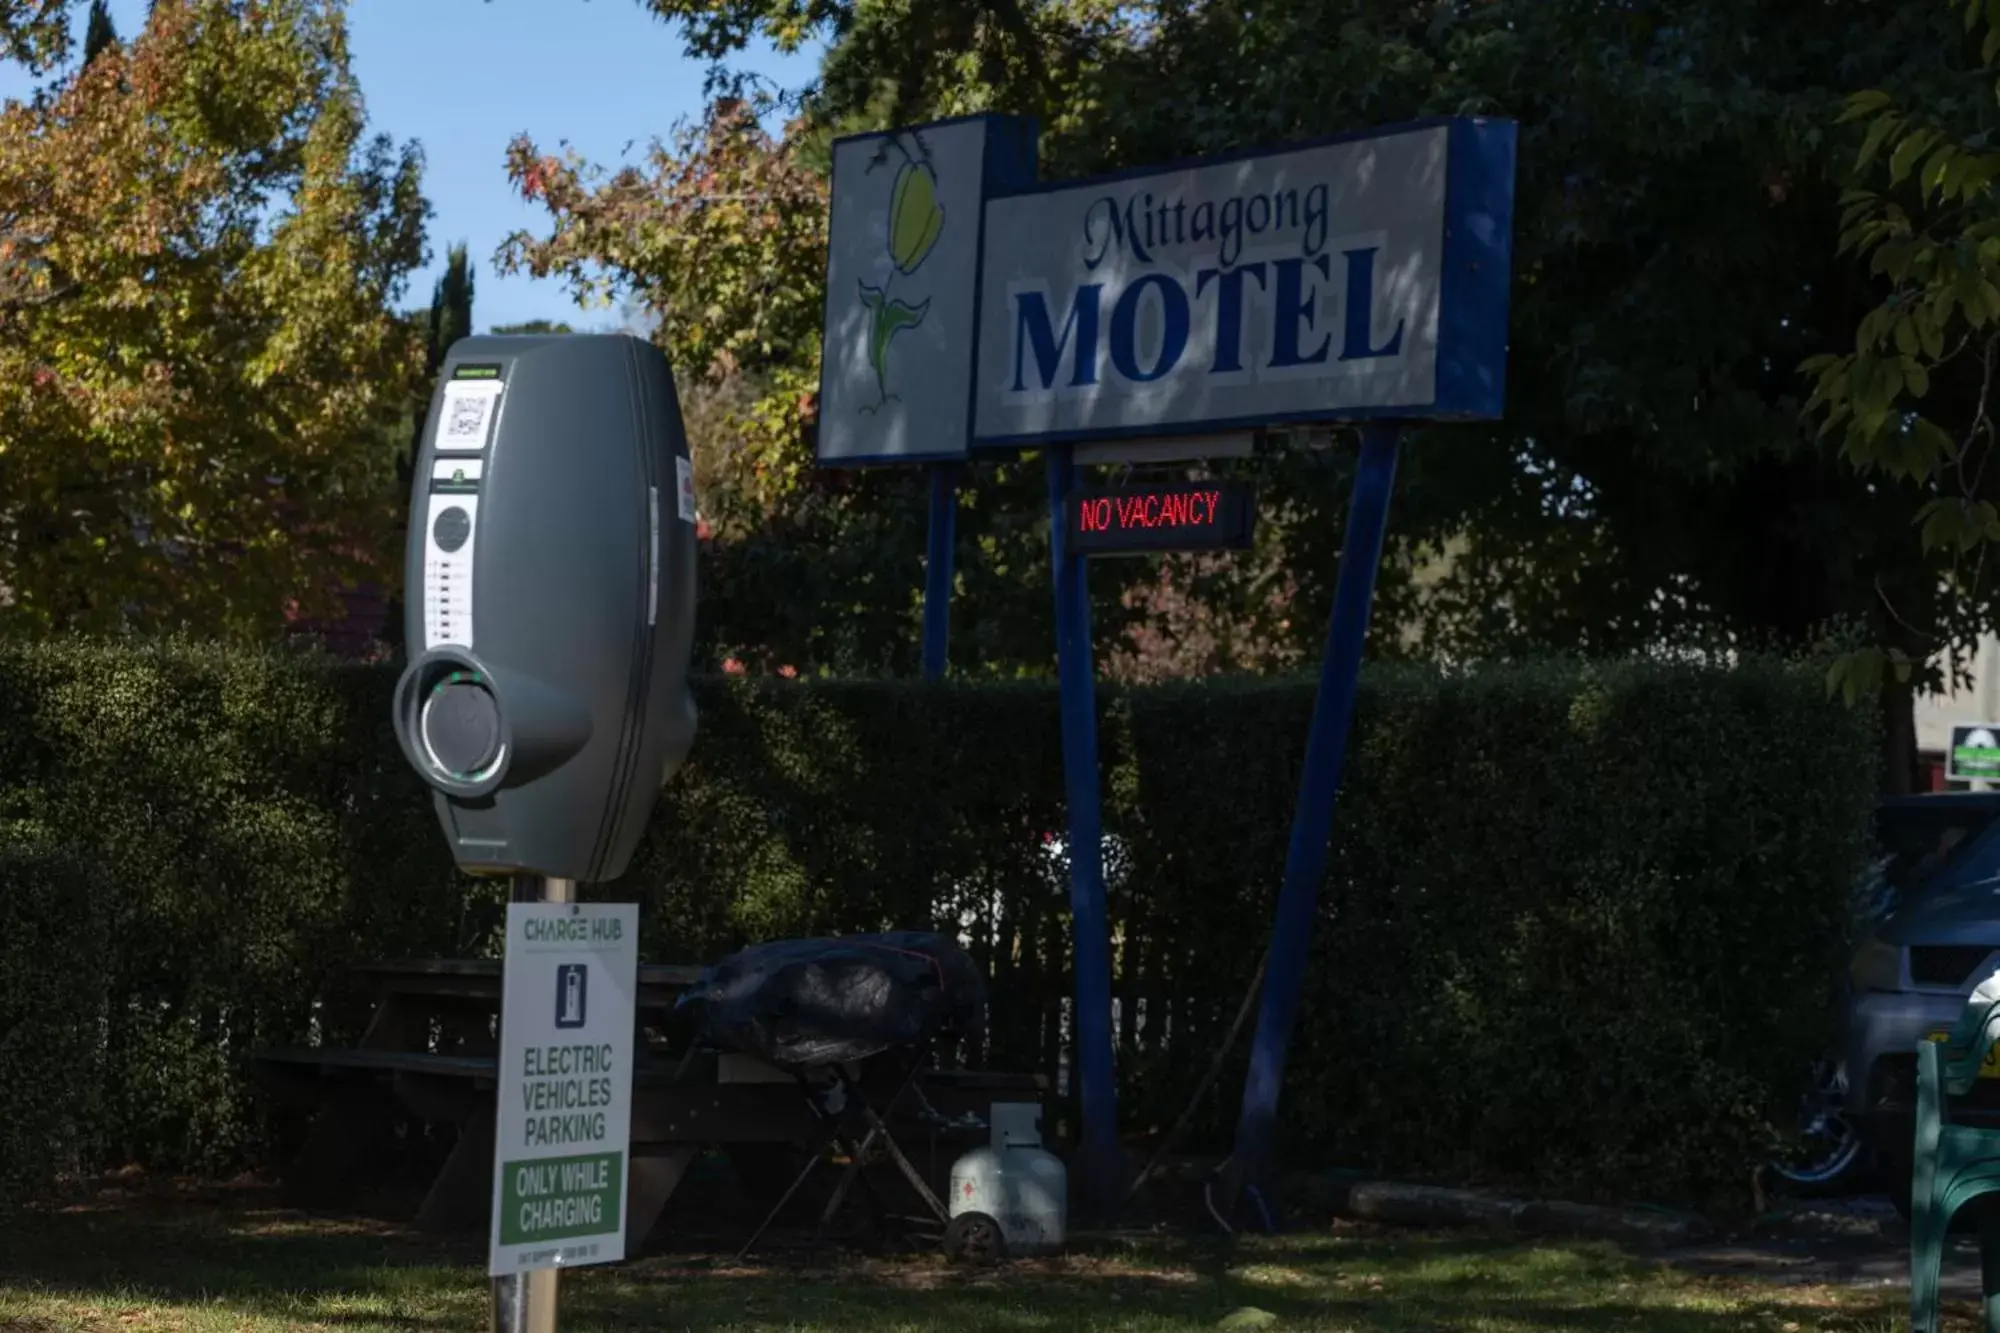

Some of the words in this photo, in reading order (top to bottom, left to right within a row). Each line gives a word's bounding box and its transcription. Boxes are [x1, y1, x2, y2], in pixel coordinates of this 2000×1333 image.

[1083, 183, 1329, 269] Mittagong
[1010, 247, 1404, 391] MOTEL
[1080, 499, 1112, 532] NO
[1116, 490, 1220, 528] VACANCY
[524, 918, 587, 941] CHARGE
[592, 918, 623, 941] HUB
[523, 1044, 612, 1077] ELECTRIC
[522, 1078, 611, 1111] VEHICLES
[524, 1112, 605, 1146] PARKING
[516, 1165, 558, 1197] ONLY
[561, 1160, 609, 1191] WHILE
[519, 1194, 602, 1232] CHARGING
